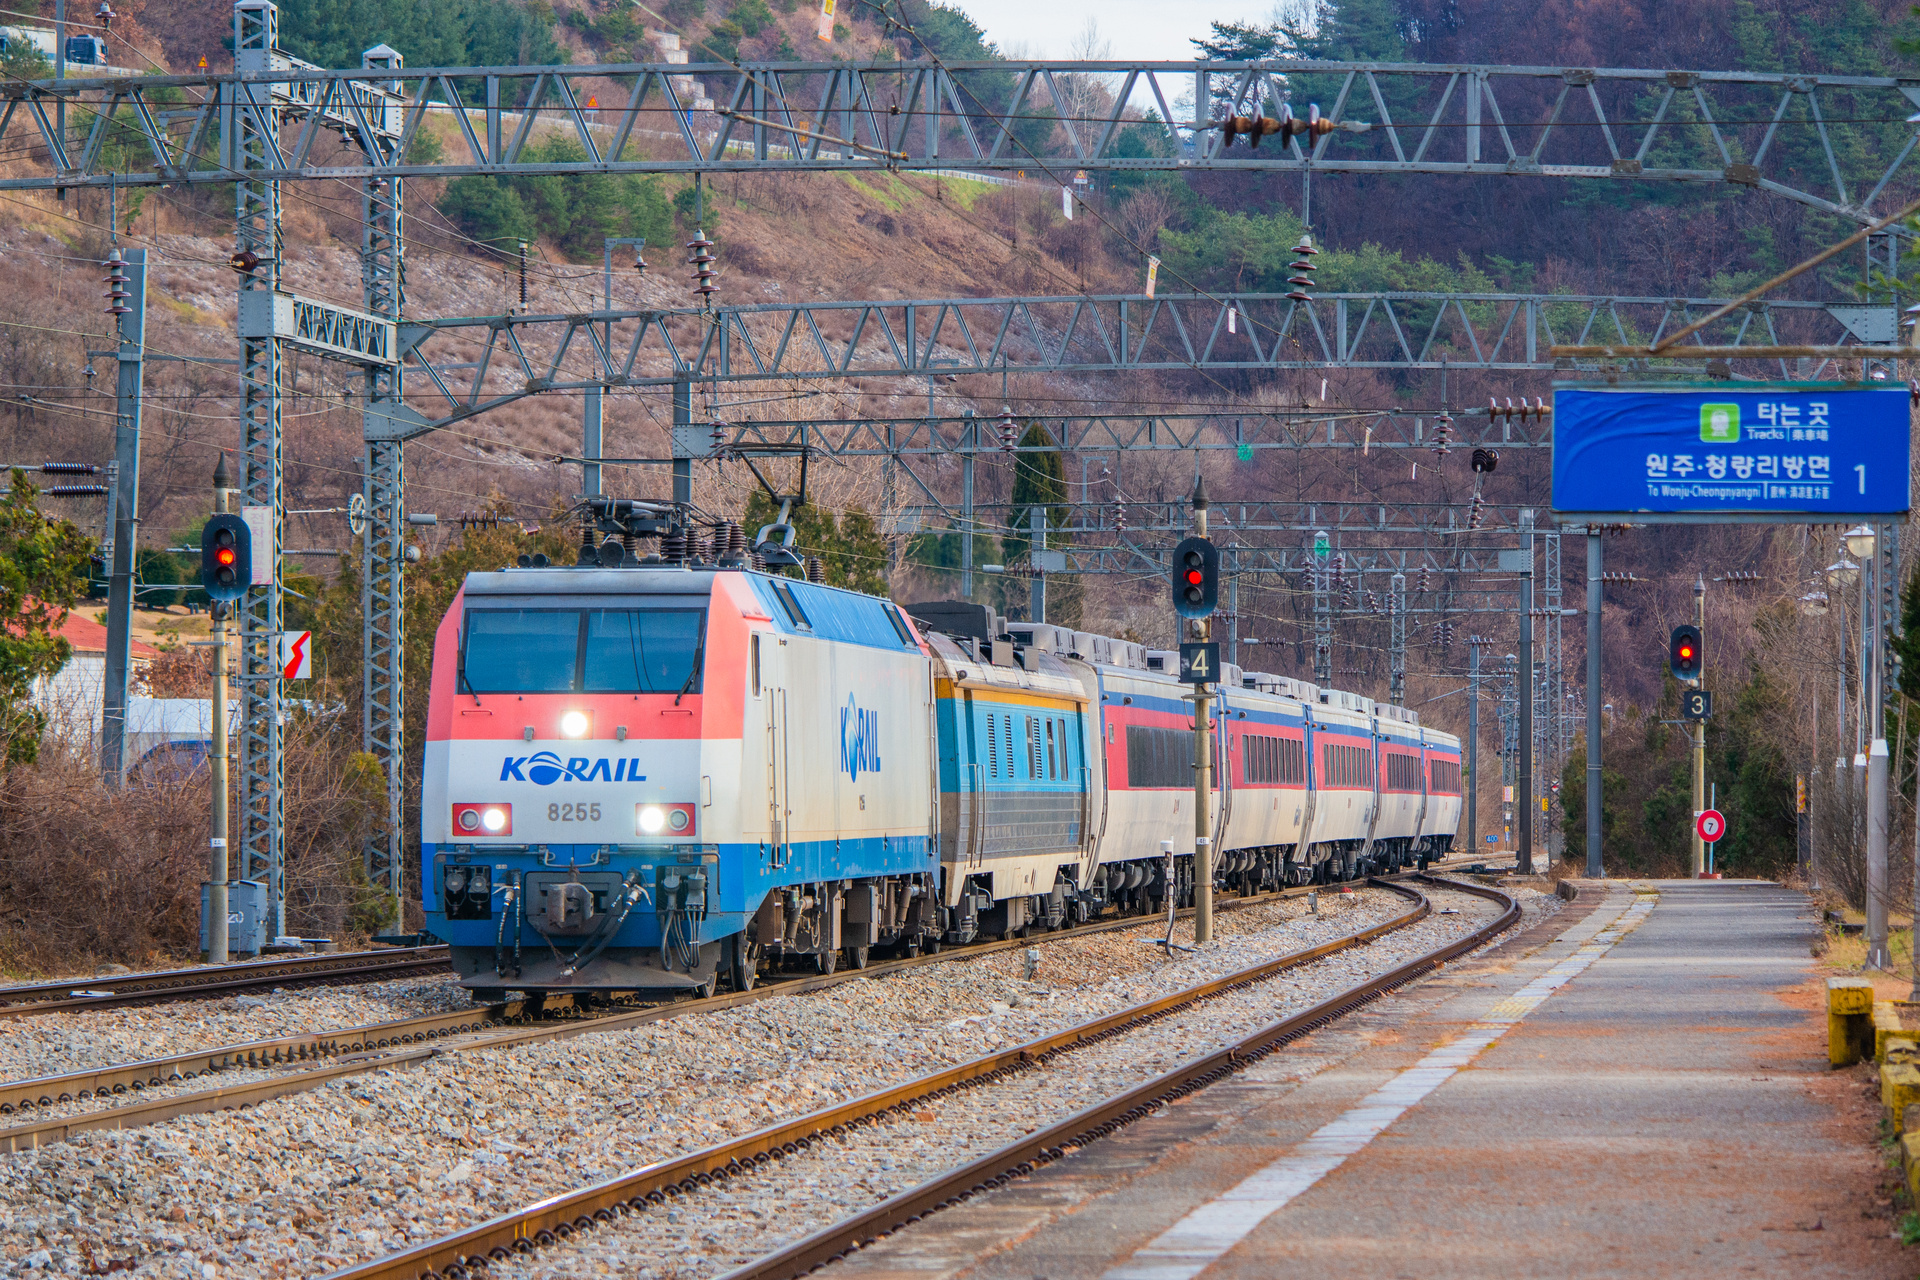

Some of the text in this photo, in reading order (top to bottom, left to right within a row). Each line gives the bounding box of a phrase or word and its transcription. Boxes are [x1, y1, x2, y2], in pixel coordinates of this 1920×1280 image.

[1757, 403, 1829, 426] 타는 곳
[1747, 428, 1785, 440] Tracks
[1854, 464, 1866, 495] 1
[1648, 485, 1659, 497] To
[1191, 648, 1209, 677] 4
[1691, 695, 1704, 714] 3
[841, 690, 881, 783] KORAIL
[500, 751, 647, 786] KORAIL
[547, 803, 601, 822] 8255
[1707, 822, 1714, 832] 7
